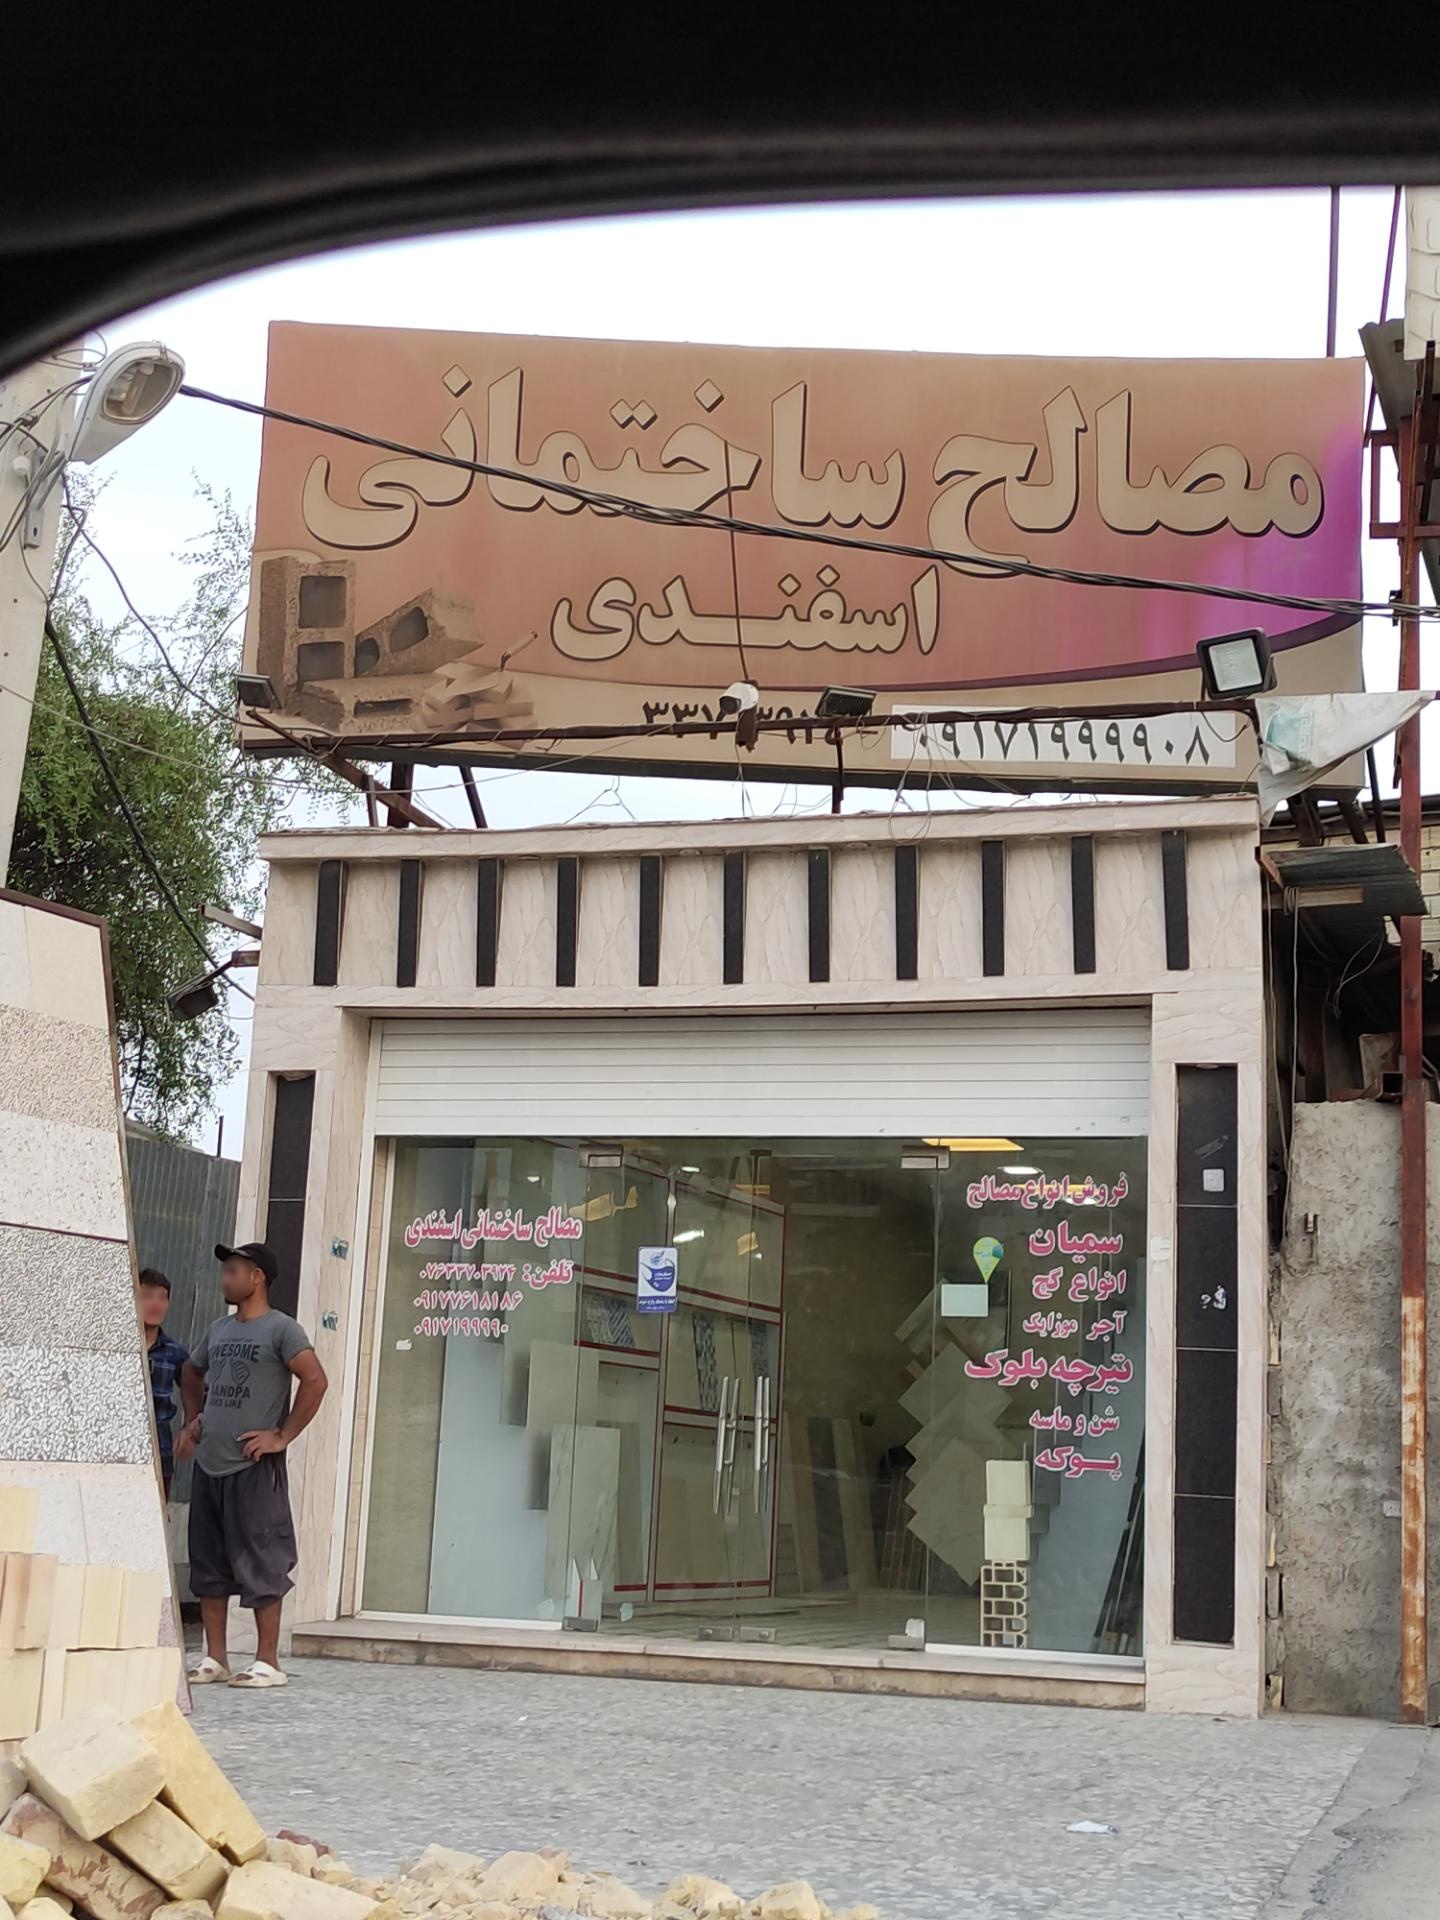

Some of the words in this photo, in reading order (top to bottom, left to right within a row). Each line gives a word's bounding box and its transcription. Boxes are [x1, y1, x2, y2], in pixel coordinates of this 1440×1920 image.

[301, 364, 905, 550] ساختمانی
[927, 385, 1325, 578] مصالح
[551, 564, 941, 662] اسفندی
[919, 719, 1211, 766] ۰۹۱۷۱۹۹۹۹۰۸
[966, 1174, 1021, 1209] مصالح
[1021, 1174, 1070, 1209] انواع
[1071, 1171, 1129, 1207] فروش
[404, 1208, 463, 1247] اسفندی
[460, 1208, 533, 1249] ساختمانی
[534, 1206, 583, 1247] مصالح
[1032, 1265, 1064, 1300] گچ
[1068, 1266, 1127, 1302] انواع
[1086, 1311, 1127, 1342] آجر
[964, 1348, 1048, 1390] بلوک
[1050, 1353, 1133, 1395] تیرچه
[1029, 1406, 1072, 1432] ماسه
[1073, 1413, 1086, 1436] و
[1088, 1405, 1120, 1436] شن
[1034, 1446, 1122, 1480] پوکه
